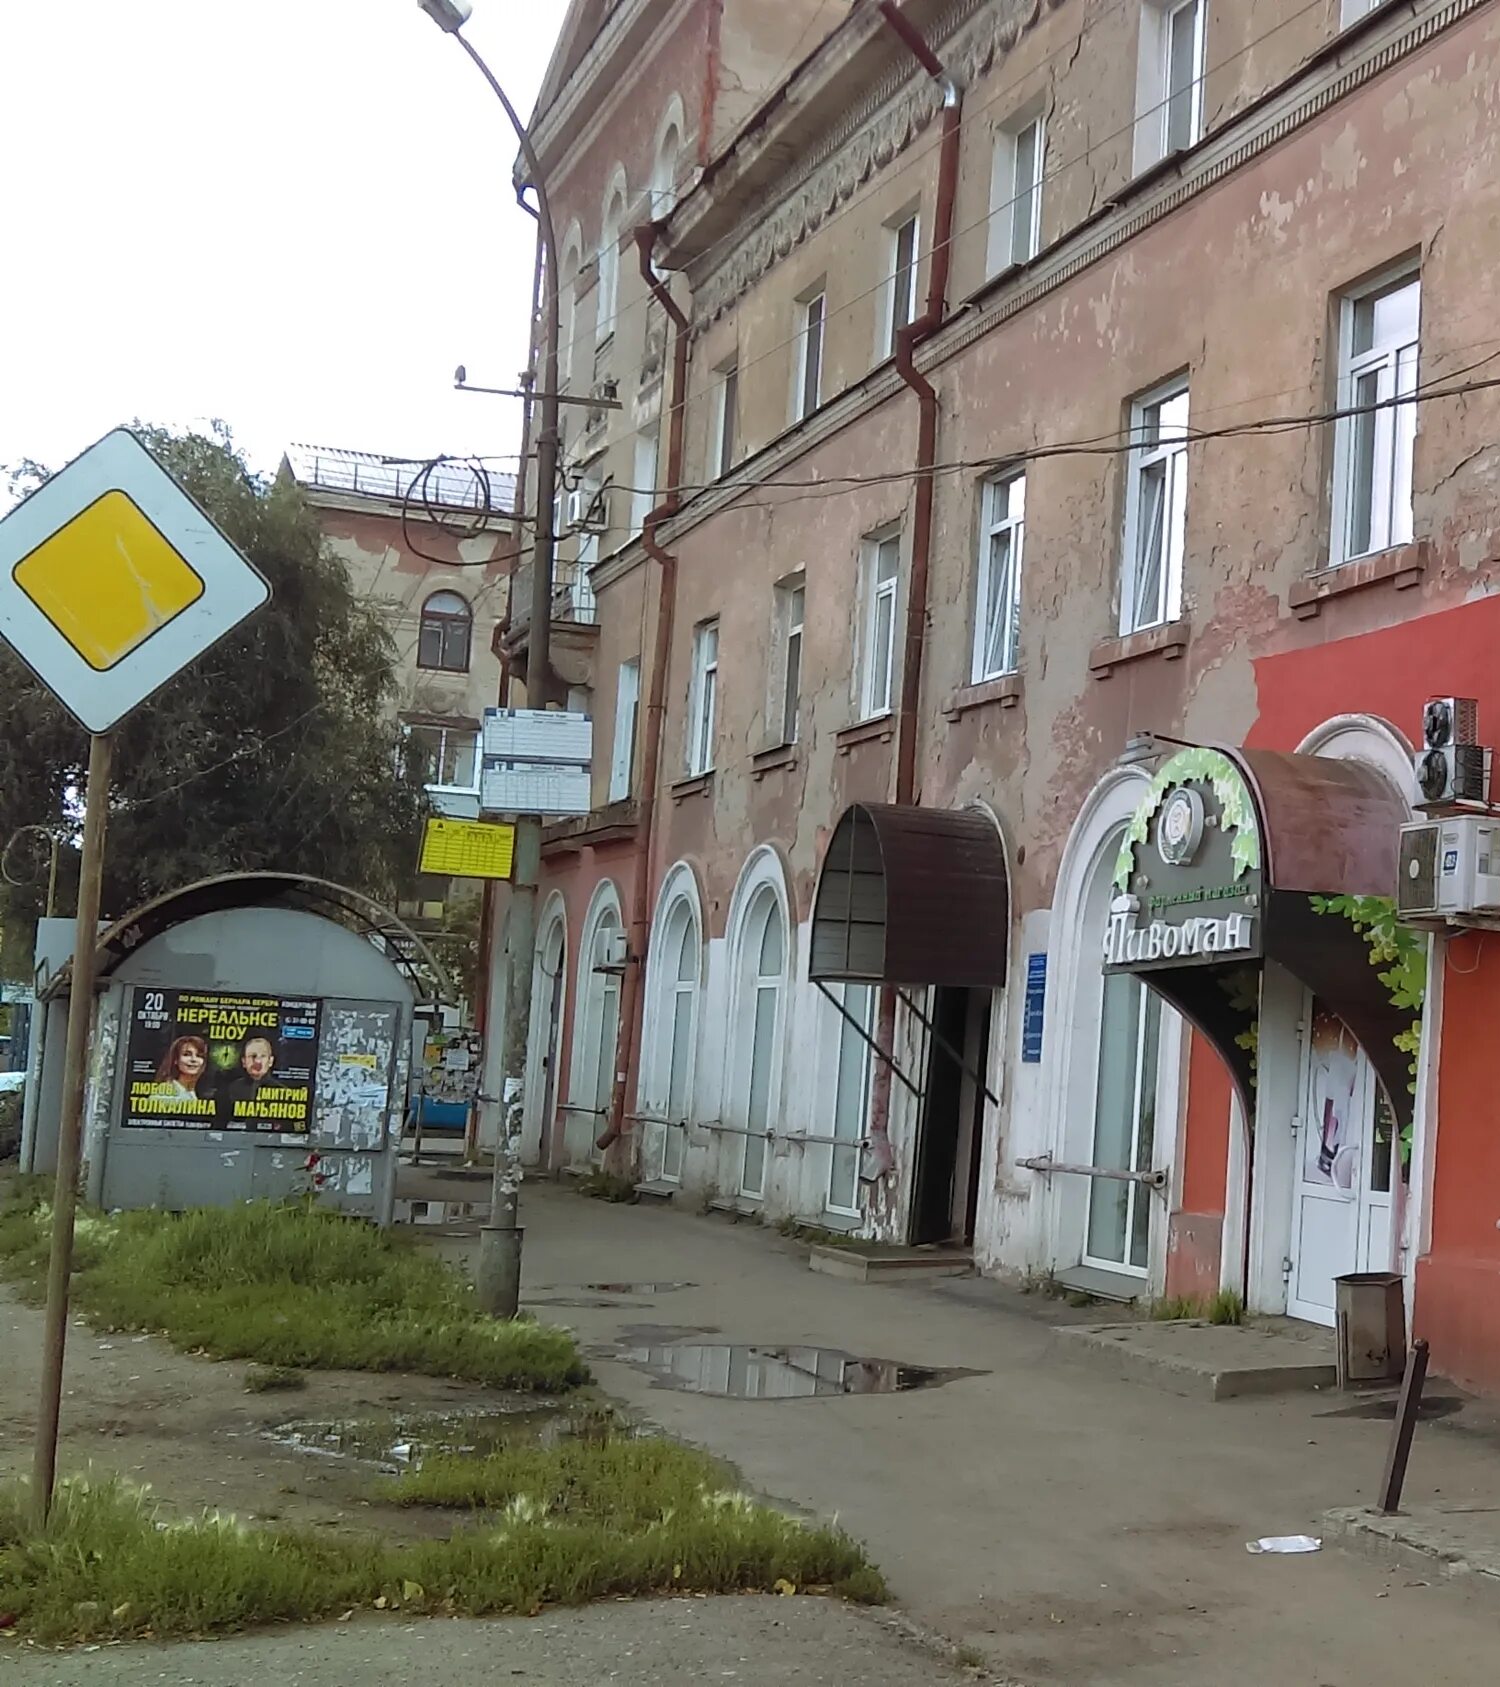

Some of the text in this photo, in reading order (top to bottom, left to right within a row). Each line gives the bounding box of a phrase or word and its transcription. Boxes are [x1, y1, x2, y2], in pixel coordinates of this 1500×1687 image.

[1102, 911, 1255, 964] Пивоман
[144, 992, 164, 1010] 20
[210, 1025, 247, 1040] ШОУ
[130, 1097, 216, 1115] ТОЛКАЛИНА
